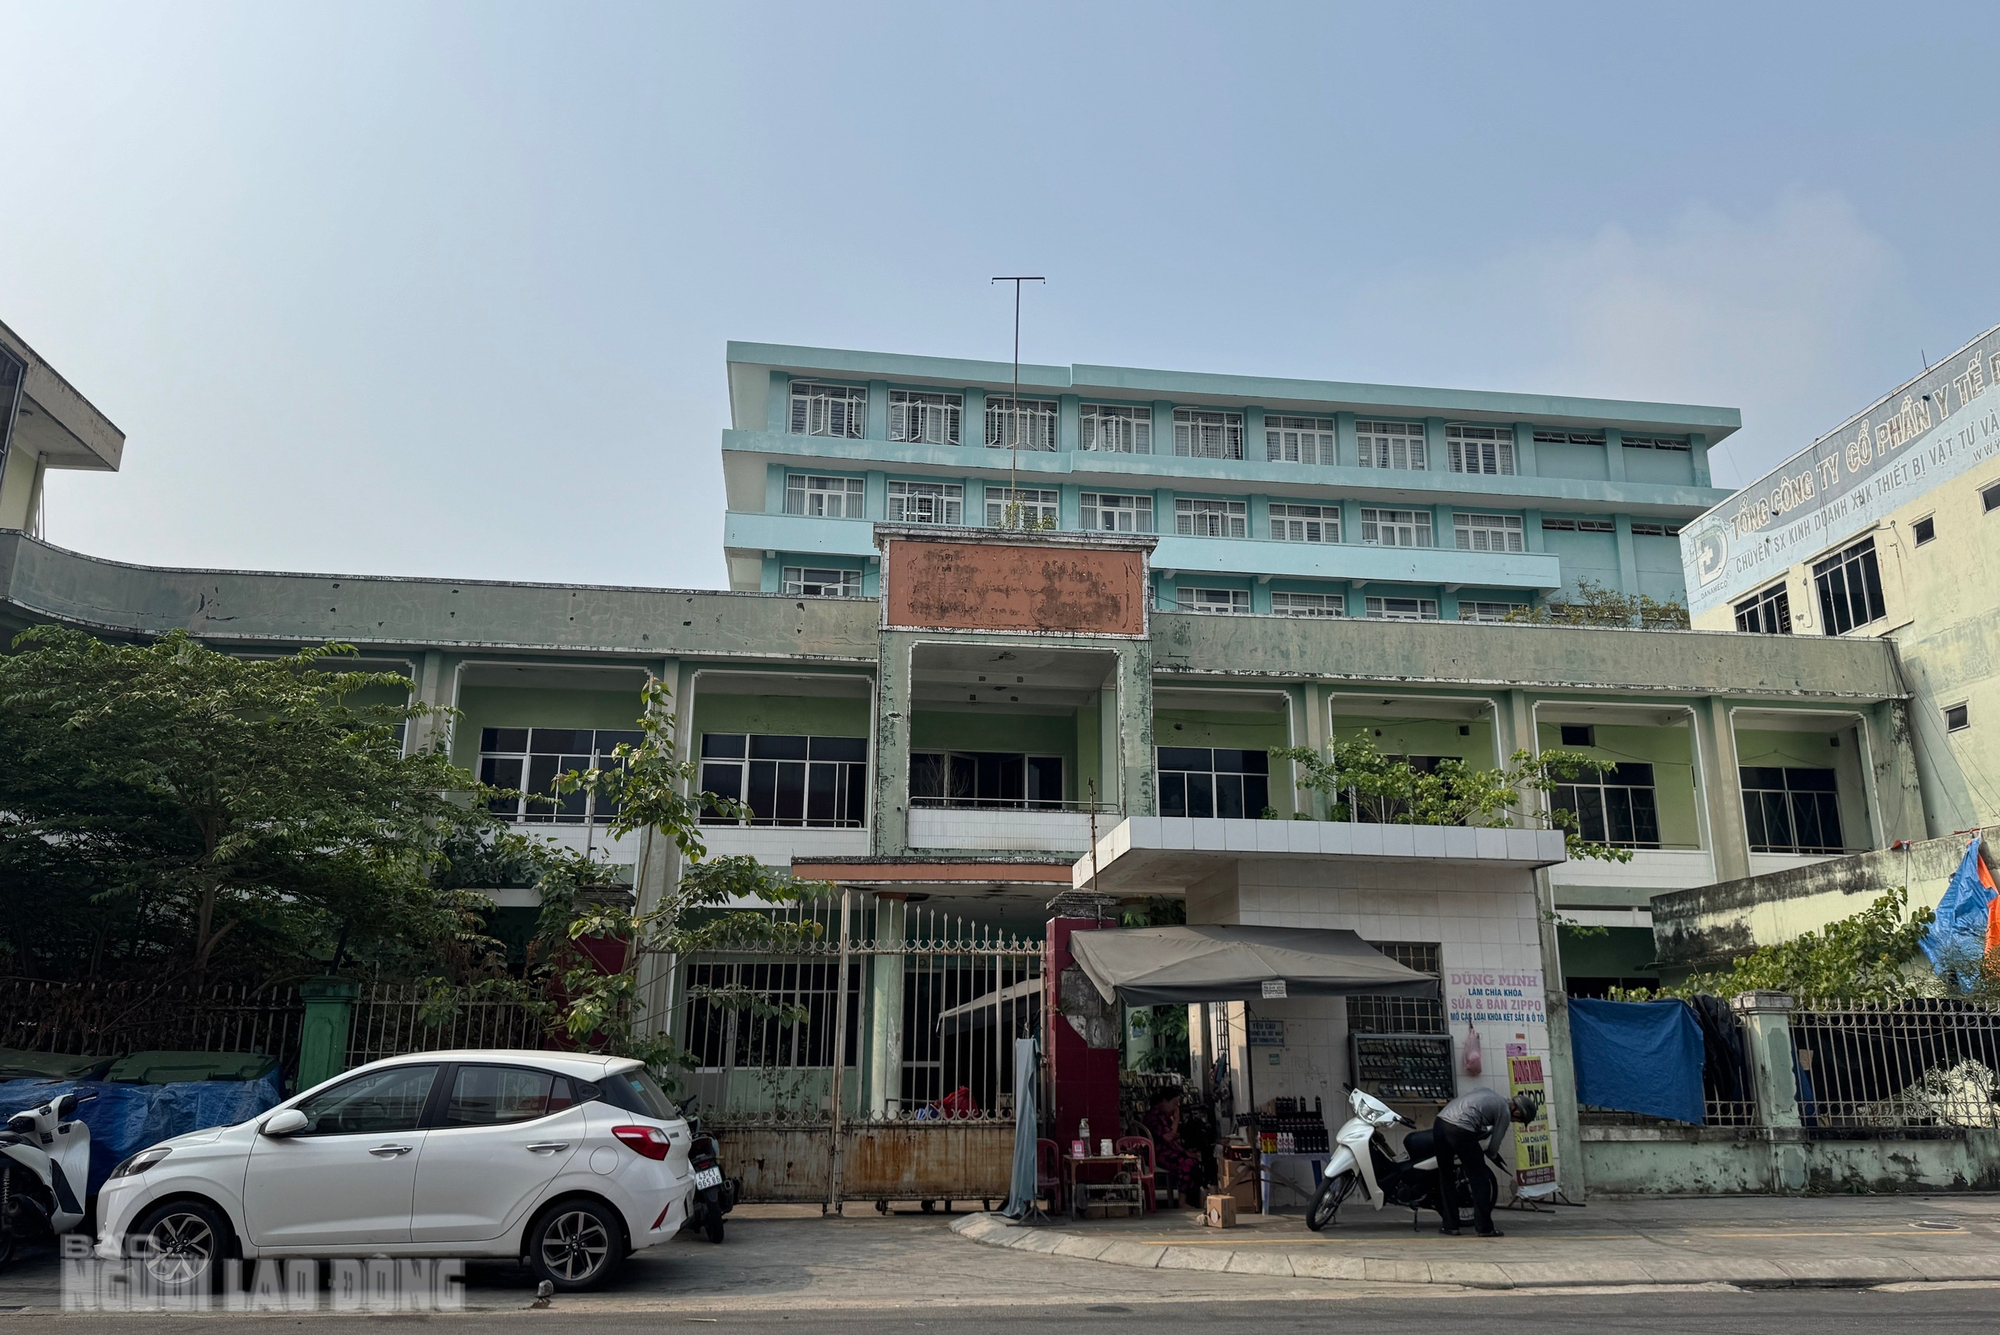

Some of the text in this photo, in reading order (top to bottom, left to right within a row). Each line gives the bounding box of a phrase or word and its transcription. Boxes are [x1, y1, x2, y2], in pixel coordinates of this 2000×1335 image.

[1730, 495, 1771, 541] TỔNG
[1770, 471, 1814, 517] CÔNG
[1816, 452, 1839, 490] TY
[1845, 419, 1873, 473] CỔ
[1874, 395, 1932, 456] PHẦN
[1932, 383, 1950, 421] Y
[1953, 350, 1986, 407] TẾ
[1736, 409, 2000, 574] CHUYÊN SX KINH DOANH XNK THIẾT BỊ VẬT TƯ VÀ
[1450, 971, 1538, 987] DŨNG MINH
[1468, 986, 1522, 997] LÀM CHÌA KHÓA
[1451, 995, 1542, 1012] SỬA & BÁN ZIPPO
